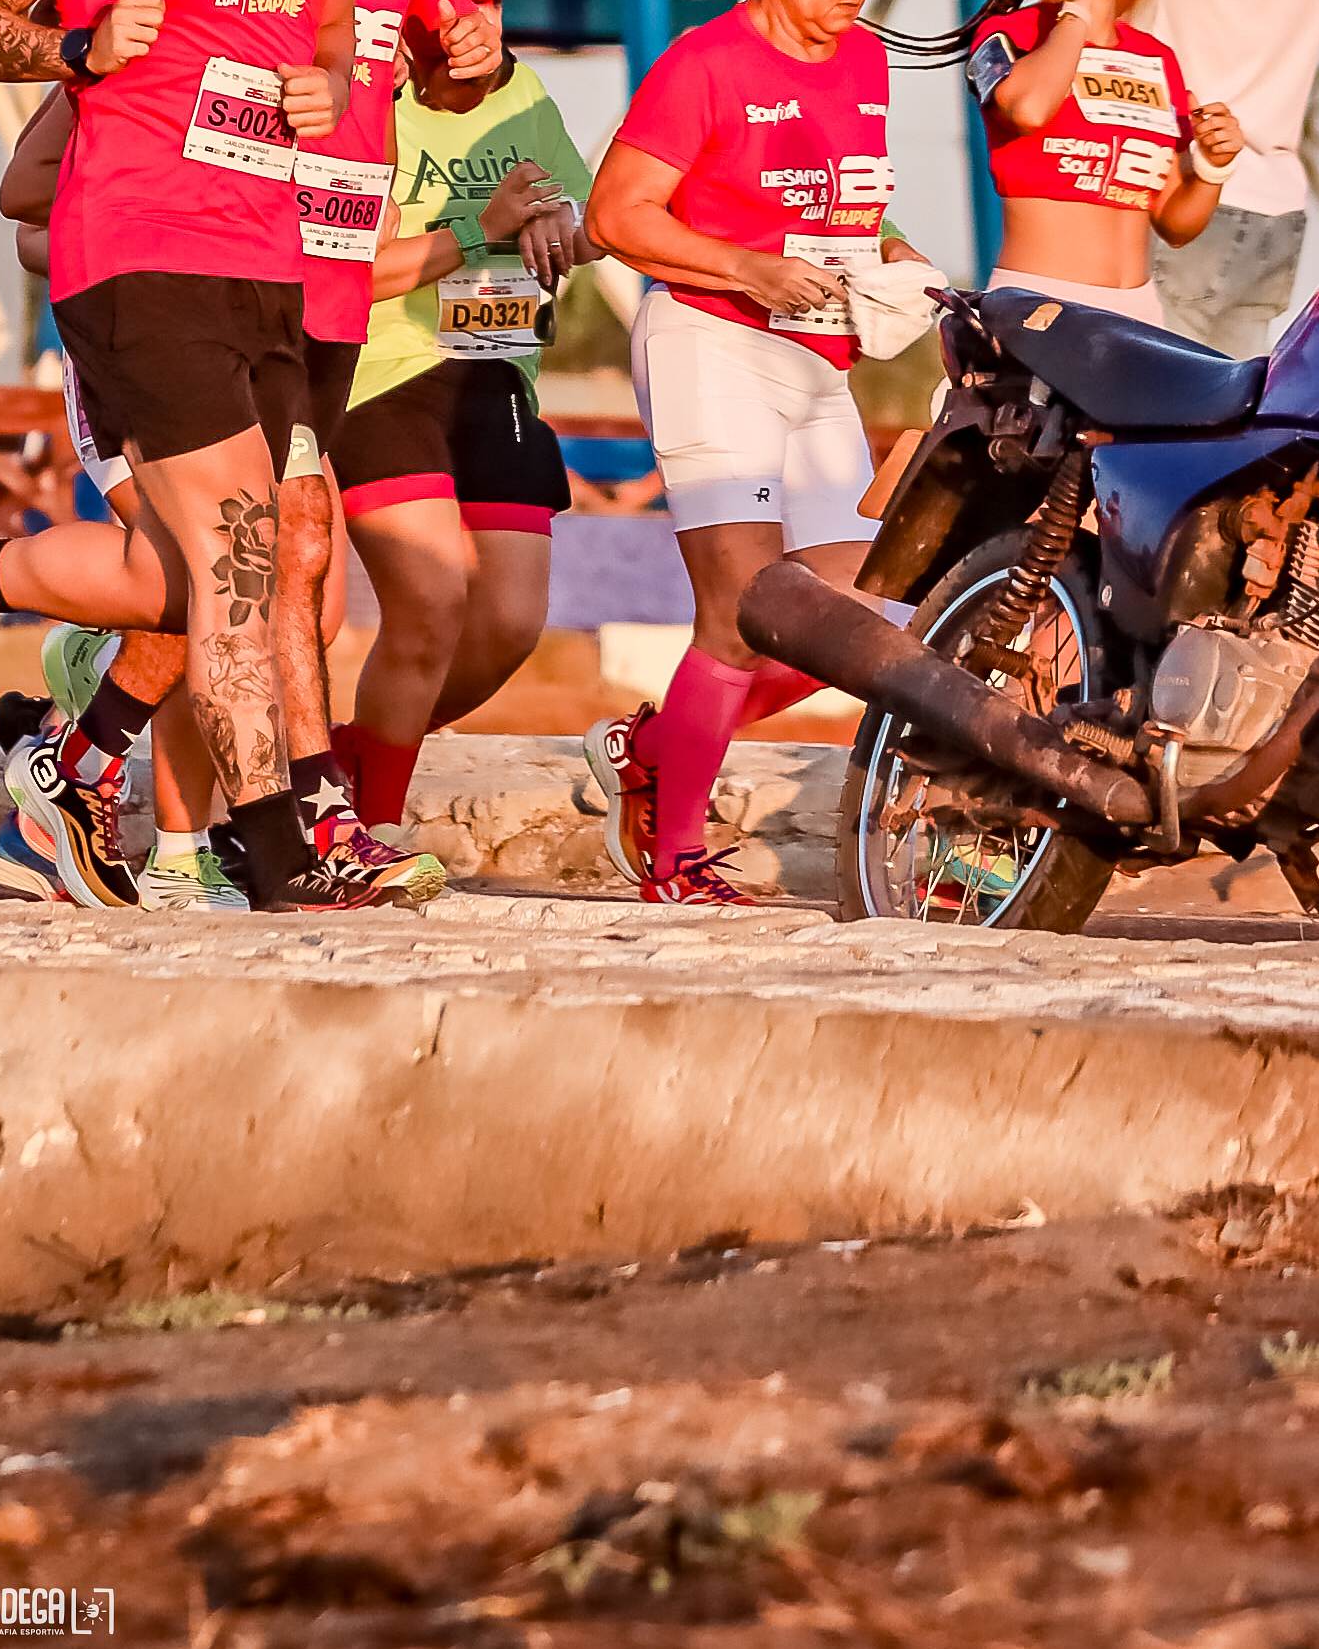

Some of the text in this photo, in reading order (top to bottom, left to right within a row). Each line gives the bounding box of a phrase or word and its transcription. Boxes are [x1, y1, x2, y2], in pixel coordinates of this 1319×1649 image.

[1084, 77, 1160, 106] D-0251
[399, 145, 522, 206] Acuid
[297, 190, 376, 226] S-0068
[782, 188, 815, 207] SOL
[452, 301, 529, 328] D-0321
